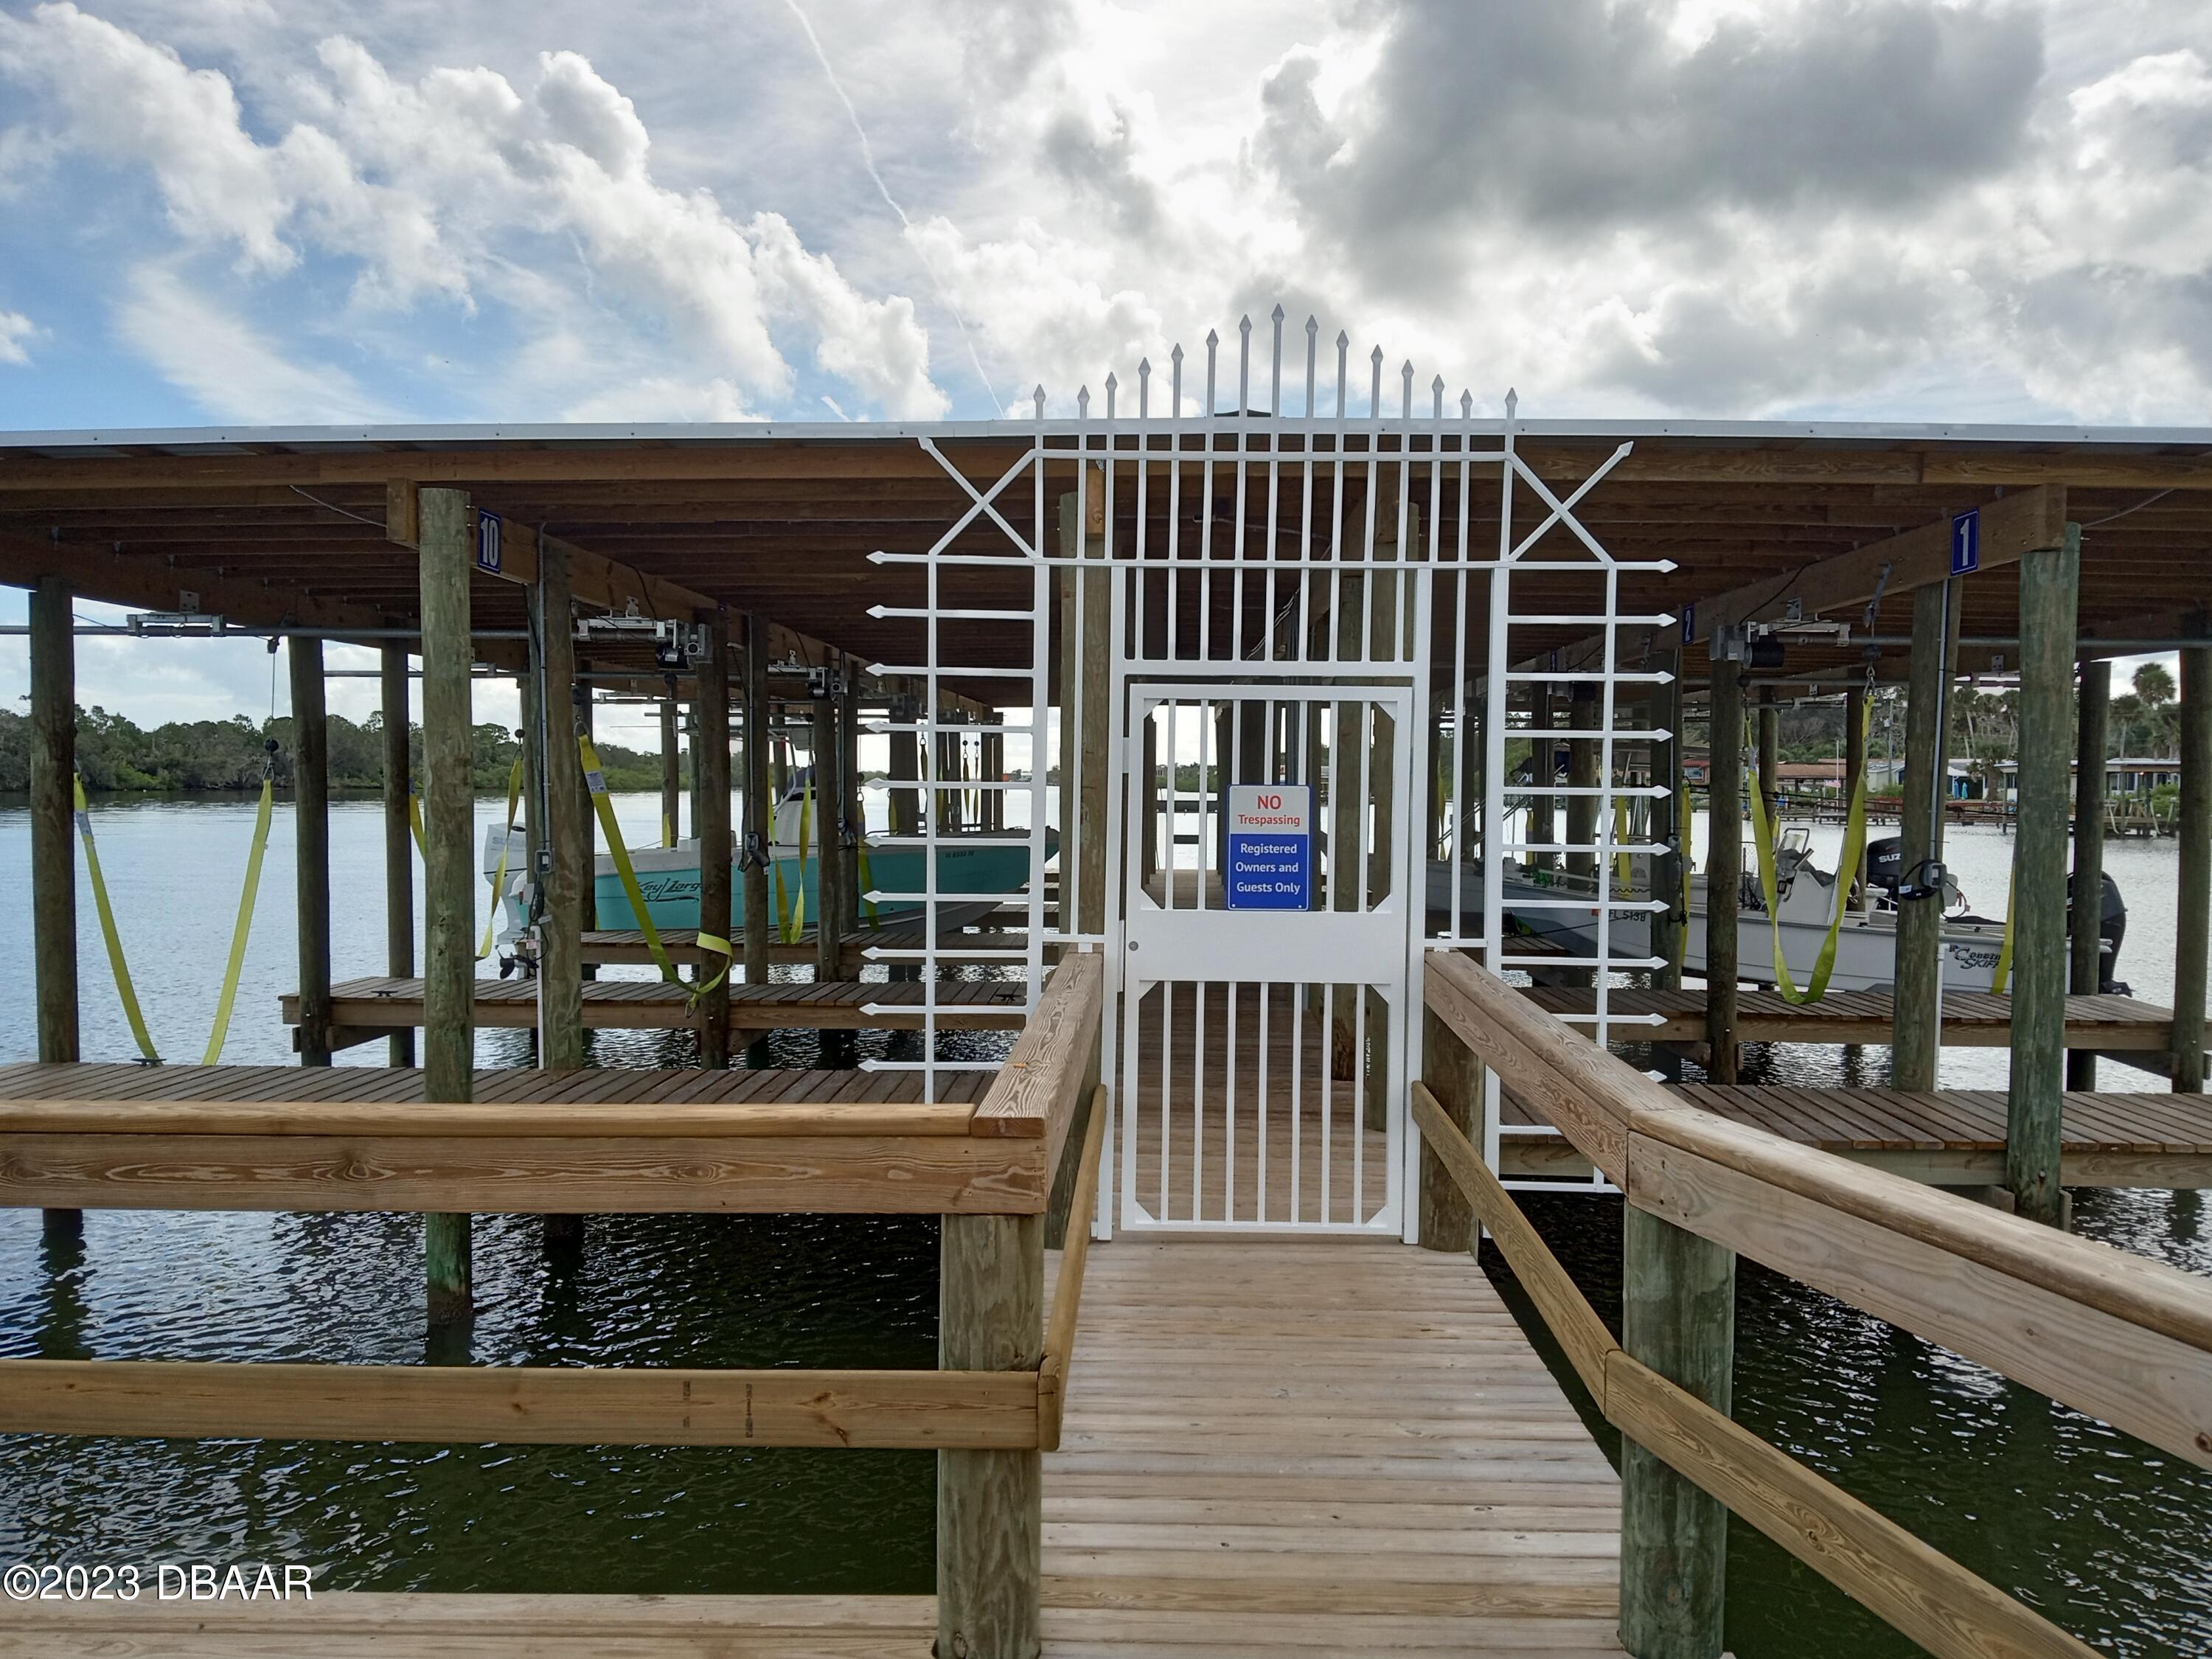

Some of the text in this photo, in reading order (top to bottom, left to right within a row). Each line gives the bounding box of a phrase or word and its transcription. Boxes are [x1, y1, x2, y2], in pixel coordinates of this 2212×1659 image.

[481, 518, 498, 567] 10
[1960, 518, 1969, 566] 1
[1685, 610, 1691, 641] 2
[1257, 795, 1281, 810] NO
[1238, 814, 1301, 827] Trespassing
[1240, 843, 1298, 855] Registered
[1235, 862, 1299, 872] Owners and
[1237, 882, 1301, 895] Guests Only
